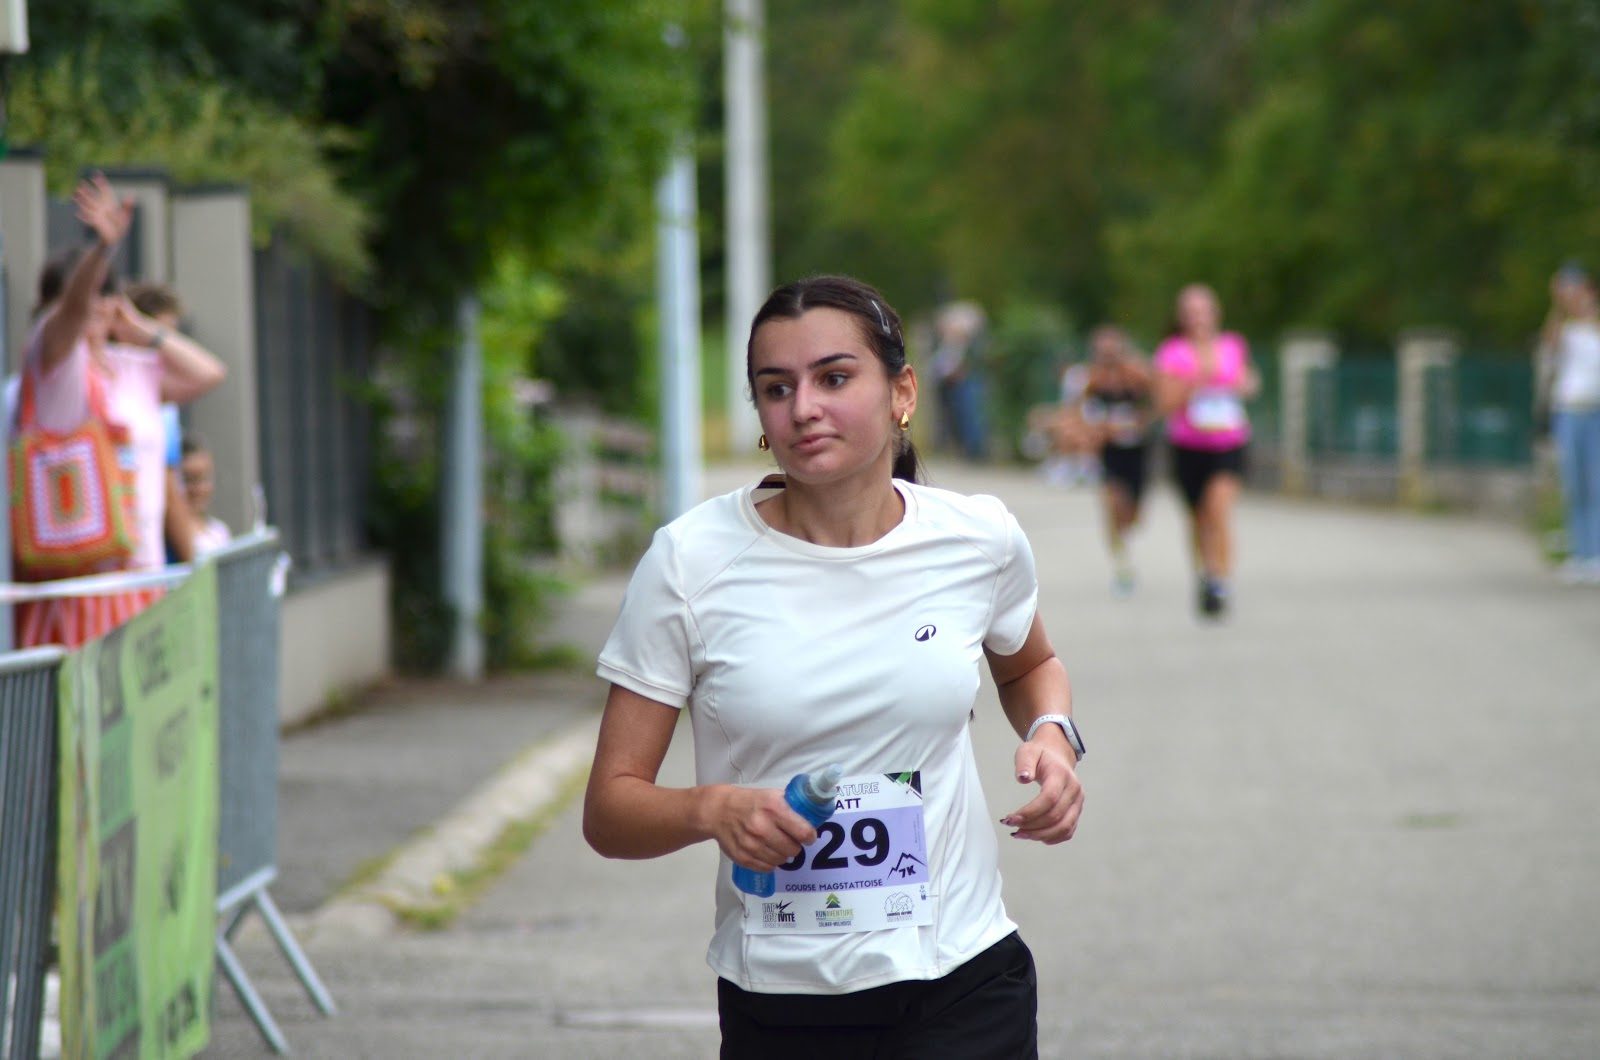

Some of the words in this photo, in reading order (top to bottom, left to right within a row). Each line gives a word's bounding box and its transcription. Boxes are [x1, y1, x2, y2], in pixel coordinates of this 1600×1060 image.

[835, 798, 861, 810] ATT
[898, 864, 917, 879] 7K
[785, 883, 817, 892] COURSE
[819, 878, 883, 891] MAGSTATTOISE
